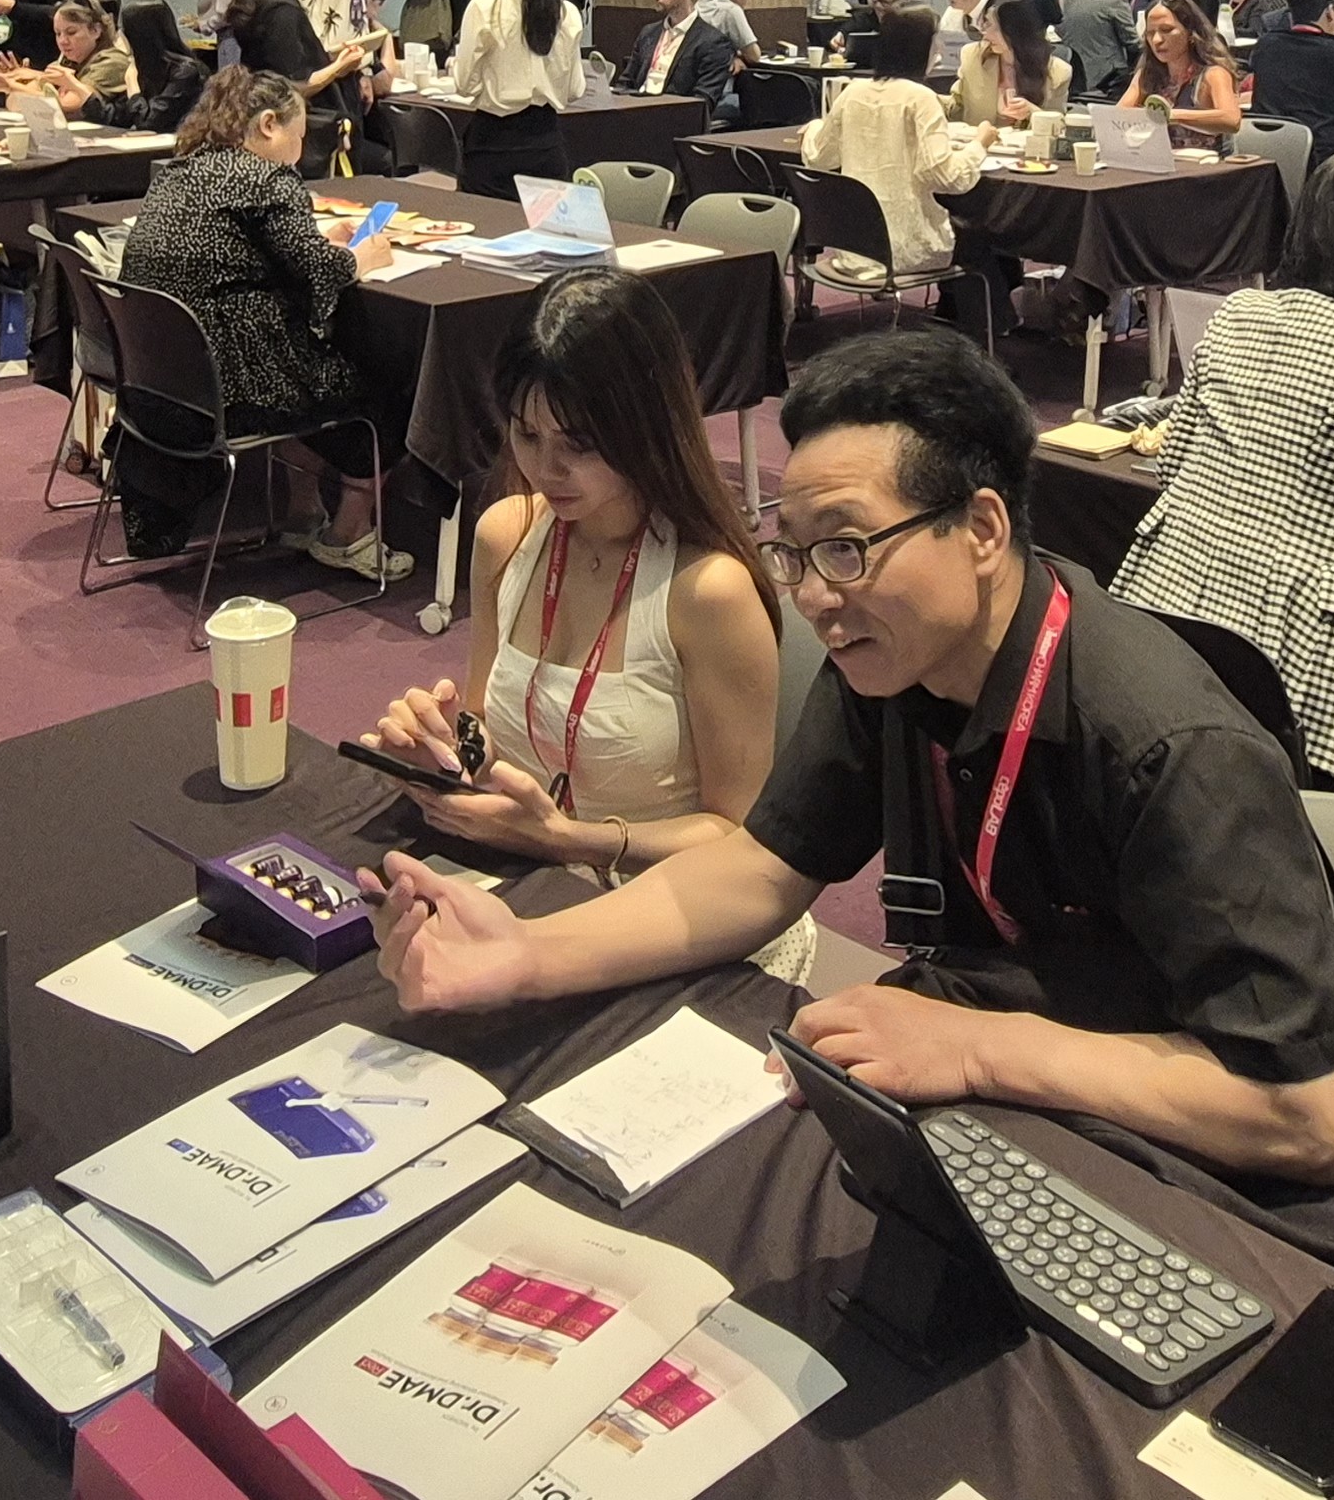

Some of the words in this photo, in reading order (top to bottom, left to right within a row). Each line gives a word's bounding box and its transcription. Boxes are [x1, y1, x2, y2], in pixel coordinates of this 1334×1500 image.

[147, 964, 233, 1000] Dr.DMAE
[182, 1147, 273, 1197] Dr.DMAE
[359, 1357, 384, 1375] Red
[377, 1369, 501, 1425] Dr.DMAE
